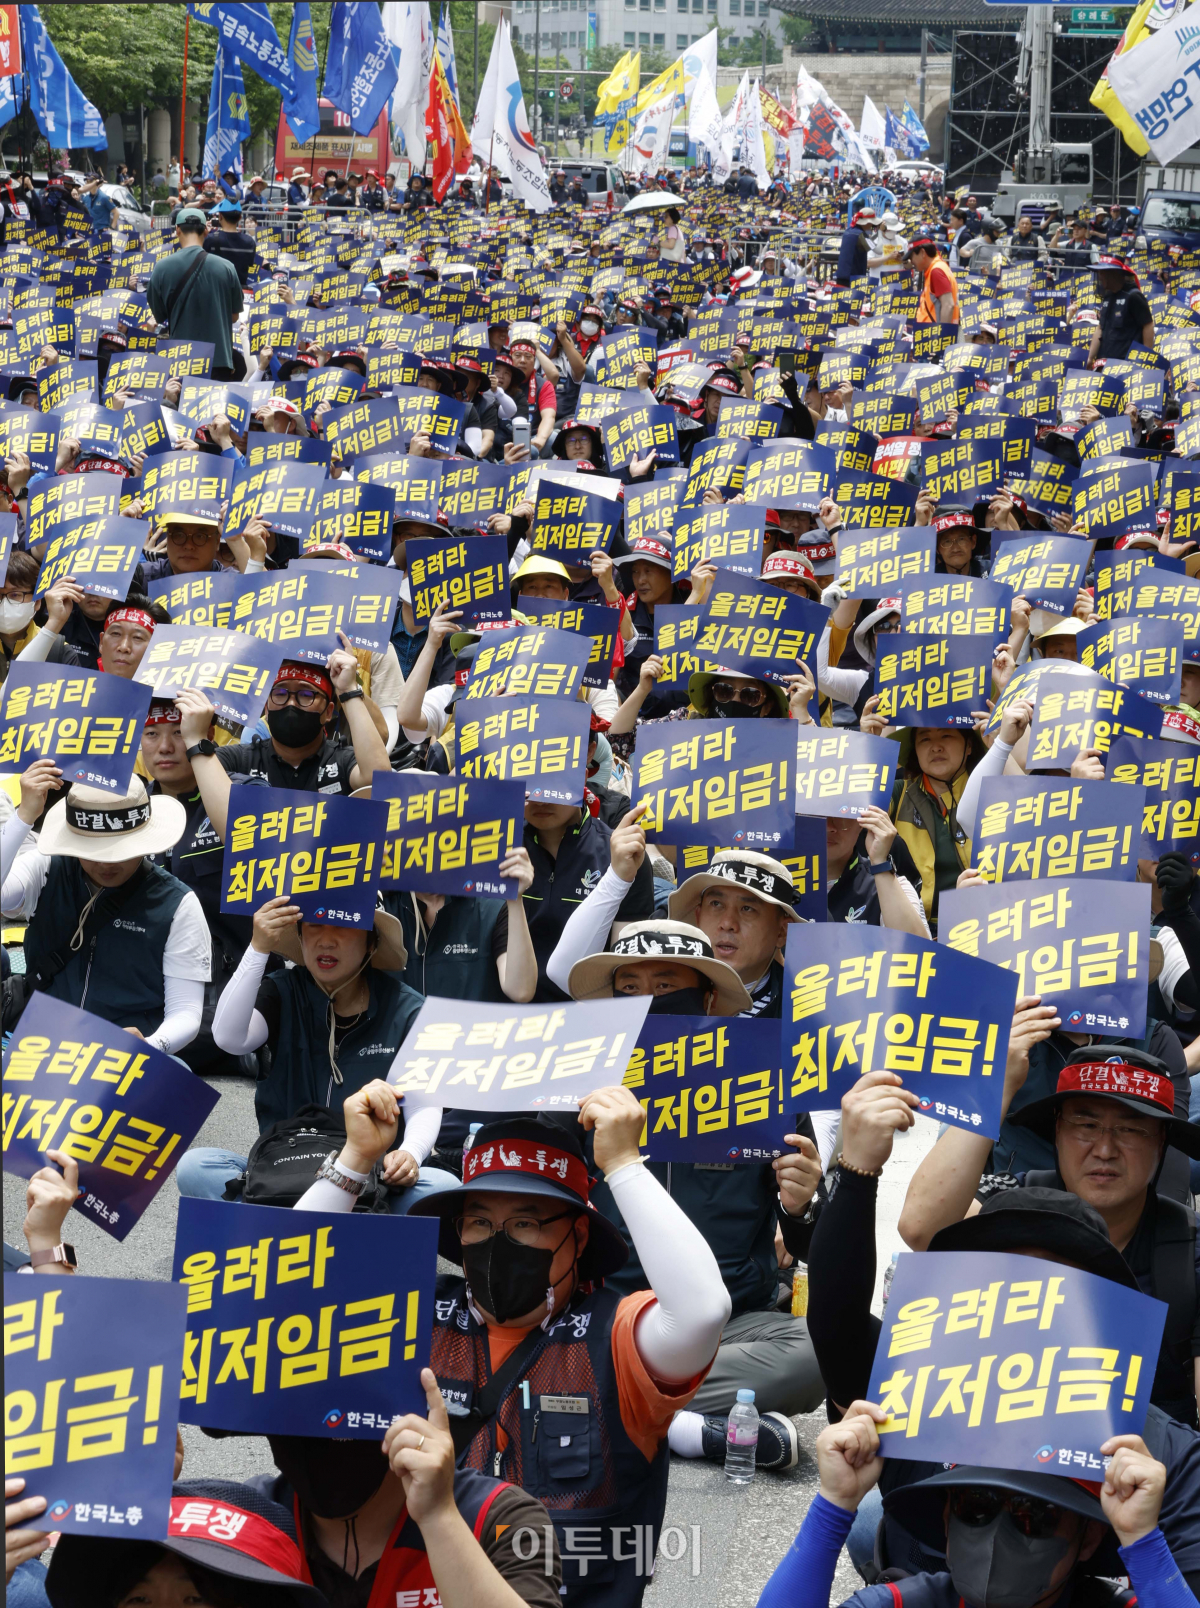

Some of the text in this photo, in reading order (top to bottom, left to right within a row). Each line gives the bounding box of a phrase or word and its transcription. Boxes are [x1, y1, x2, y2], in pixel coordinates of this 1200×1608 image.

[562, 86, 571, 94] 50
[810, 103, 836, 133] 단결!
[807, 129, 836, 159] 투쟁!
[1030, 192, 1059, 200] KATO
[321, 285, 362, 303] 최저임금!
[323, 274, 348, 291] 올려라
[490, 306, 531, 324] 최저임금!
[491, 296, 518, 310] 올려라
[16, 310, 54, 335] 올려라
[251, 317, 283, 336] 올려라
[365, 327, 417, 344] 최저임금!
[369, 314, 404, 329] 올려라
[752, 320, 784, 337] 올려라
[914, 325, 942, 342] 올려라
[18, 324, 74, 354] 최저임금!
[250, 331, 298, 353] 최저임금!
[605, 333, 640, 353] 올려라
[750, 334, 797, 352] 최저임금!
[914, 336, 957, 356] 최저임금!
[108, 355, 147, 377] 올려라
[369, 352, 404, 373] 올려라
[819, 356, 851, 373] 올려라
[306, 370, 342, 392] 올려라
[367, 368, 419, 389] 최저임금!
[820, 367, 866, 390] 최저임금!
[1066, 375, 1104, 391] 올려라
[304, 385, 358, 410] 최저임금!
[720, 403, 761, 421] 올려라
[853, 396, 893, 418] 올려라
[1061, 390, 1120, 408] 최저임금!
[326, 404, 370, 442] 올려라
[606, 407, 649, 446] 올려라
[718, 420, 778, 439] 최저임금!
[610, 423, 675, 467] 최저임금!
[690, 442, 737, 477] 올려라
[874, 441, 907, 461] 윤석열
[924, 442, 973, 476] 올려라
[143, 454, 199, 490] 올려라
[747, 450, 804, 481] 올려라
[926, 459, 999, 499] 최저임금!
[30, 476, 85, 517] 올려라
[142, 477, 227, 514] 최저임금!
[232, 464, 287, 506] 올려라
[744, 472, 829, 502] 최저임금!
[836, 481, 891, 501] 올려라
[1074, 472, 1121, 512] 올려라
[29, 495, 115, 544] 최저임금!
[225, 487, 315, 534] 최저임금!
[537, 495, 588, 519] 올려라
[1075, 485, 1150, 534] 최저임금!
[45, 518, 106, 563] 올려라
[533, 522, 612, 551] 최저임금!
[674, 508, 731, 548] 올려라
[411, 542, 467, 586] 올려라
[674, 529, 759, 577] 최저임금!
[839, 531, 901, 567] 올려라
[993, 540, 1053, 577] 올려라
[36, 545, 137, 595] 최저임금!
[838, 549, 930, 593] 최저임금!
[235, 575, 307, 620] 올려라
[415, 563, 504, 620] 최저임금!
[709, 592, 788, 621] 올려라
[906, 581, 973, 616] 올려라
[480, 611, 503, 619] 한국노총
[146, 634, 236, 663] 올려라
[355, 636, 379, 648] 한국노총
[473, 632, 546, 675] 올려라
[696, 622, 815, 660] 최저임금!
[1081, 621, 1142, 668] 올려라
[879, 639, 948, 683] 올려라
[5, 677, 97, 720] 올려라
[876, 665, 986, 718] 최저임금!
[1039, 689, 1124, 723] 올려라
[1147, 691, 1171, 700] 한국노총
[221, 704, 248, 720] 한국노총
[0, 717, 137, 764] 최저임금!
[459, 704, 540, 755] 올려라
[638, 725, 736, 788] 올려라
[87, 772, 118, 788] 한국노총
[543, 789, 573, 801] 한국노총
[385, 783, 469, 832] 올려라
[635, 760, 787, 833] 최저임금!
[75, 811, 104, 830] 단결
[231, 802, 327, 853] 올려라
[980, 786, 1083, 839] 올려라
[380, 818, 515, 880] 최저임금!
[747, 831, 781, 842] 한국노총
[977, 825, 1132, 883] 최저임금!
[226, 843, 375, 903] 최저임금!
[475, 881, 507, 894] 한국노총
[738, 866, 774, 893] 투쟁
[327, 909, 361, 922] 한국노총
[946, 887, 1073, 957] 올려라
[665, 936, 703, 956] 투쟁
[998, 931, 1139, 999] 임금!
[791, 951, 937, 1022] 올려라
[413, 1008, 567, 1051] 올려라
[1086, 1013, 1129, 1029] 한국노총
[3, 1036, 150, 1096] 올려라
[394, 1032, 627, 1095] 최저임금!
[622, 1026, 730, 1089] 올려라
[791, 1012, 999, 1098] 최저임금!
[1079, 1066, 1160, 1092] 단결 투쟁
[935, 1101, 983, 1126] 한국노총
[273, 1153, 310, 1166] CONTAIN
[468, 1144, 569, 1179] 단결 투쟁
[742, 1148, 782, 1159] 한국노총
[84, 1193, 120, 1224] 한국노총
[179, 1226, 335, 1313] 올려라
[888, 1277, 1065, 1358] 올려라
[179, 1290, 419, 1404] 최저임금!
[876, 1347, 1143, 1438] 최저임금!
[74, 1503, 143, 1526] 한국노총
[173, 1501, 247, 1541] 투쟁
